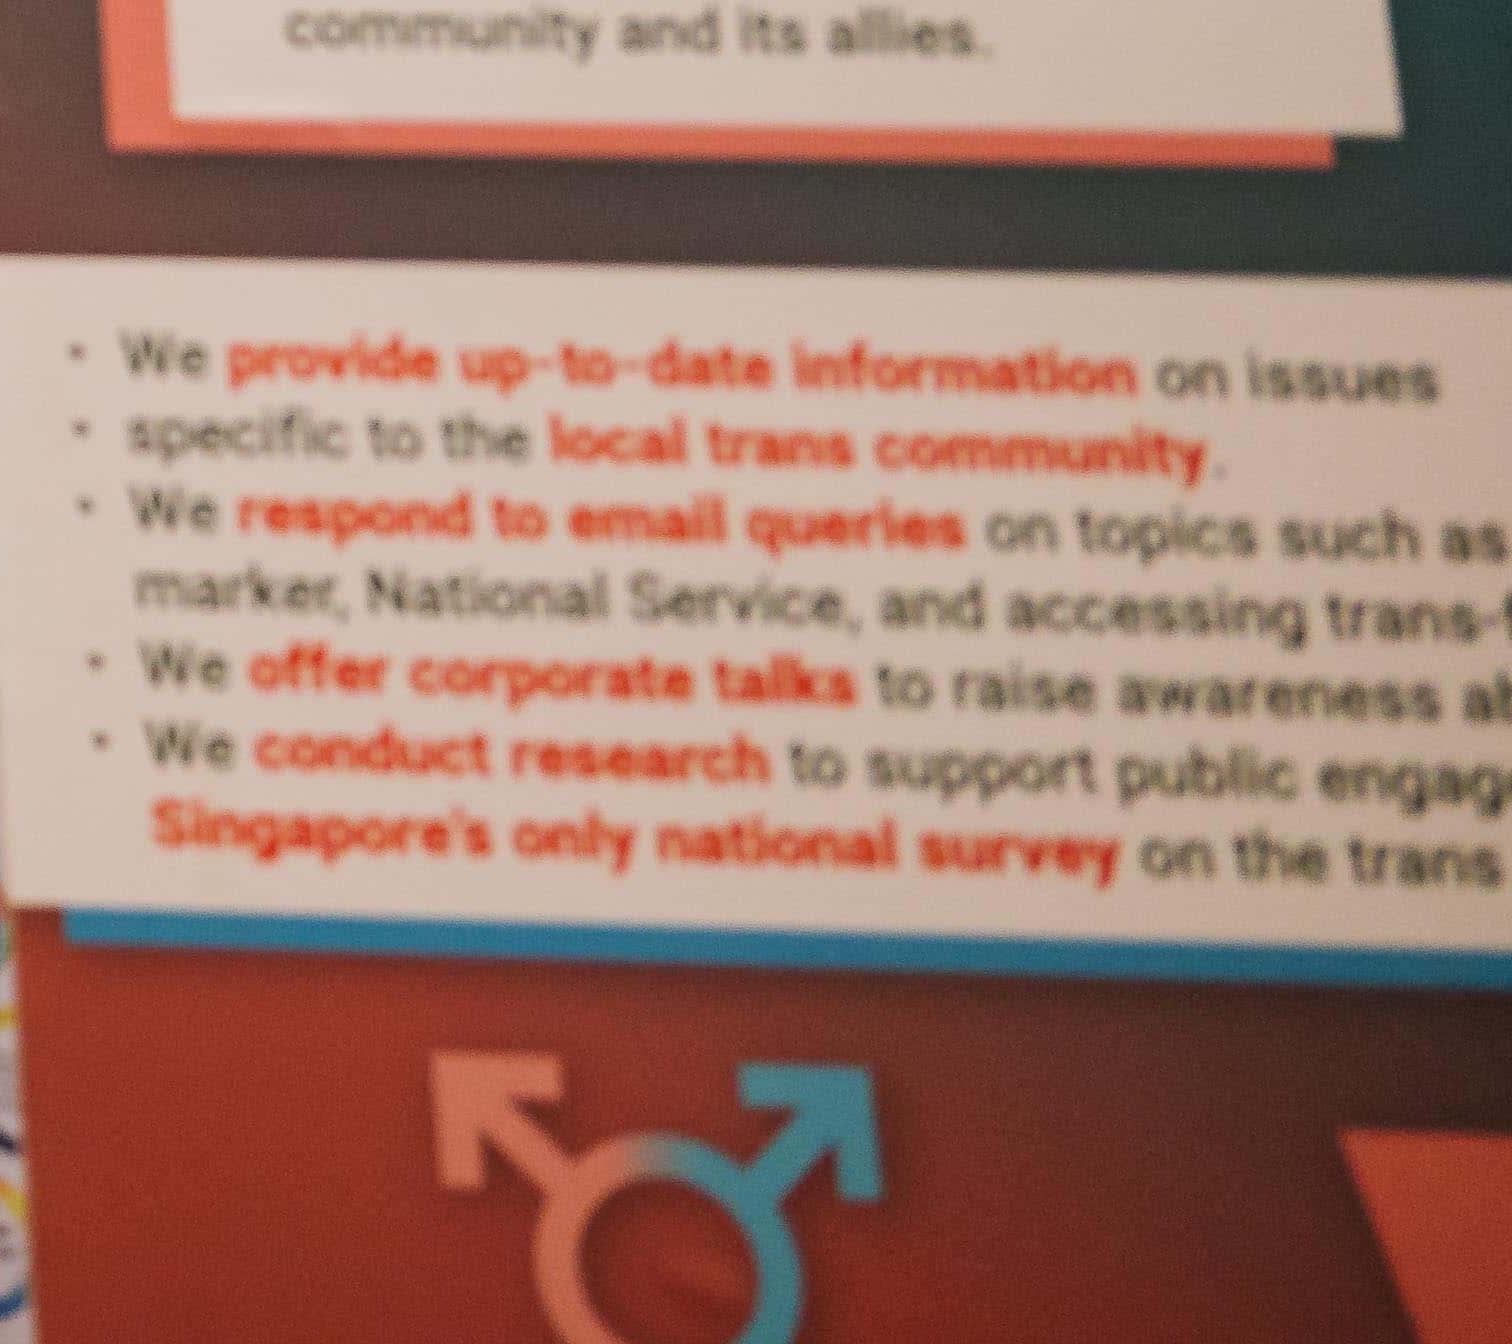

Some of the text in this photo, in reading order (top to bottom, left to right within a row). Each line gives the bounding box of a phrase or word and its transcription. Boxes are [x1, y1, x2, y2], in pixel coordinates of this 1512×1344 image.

[282, 6, 995, 64] community and its allies.
[118, 330, 1442, 404] We provide up-to-date information on issues
[126, 409, 351, 462] specific
[367, 415, 425, 462] to
[439, 415, 533, 465] the
[547, 412, 690, 466] local
[705, 421, 855, 471] trans
[127, 485, 1510, 567] We respond to email queries on topics such as
[132, 565, 349, 622] marker,
[365, 566, 610, 621] National
[626, 570, 862, 634] Service,
[879, 579, 987, 633] and
[1006, 583, 1309, 652] accessing
[138, 638, 231, 688] We
[247, 642, 390, 694] offer
[408, 654, 695, 712] corporate
[712, 655, 858, 709] talks
[875, 663, 935, 712] to
[951, 662, 1099, 714] raise
[1117, 672, 1443, 723] awareness
[142, 717, 1512, 819] We conduct research to support public engag
[150, 797, 1505, 889] Singapore's only national survey on the trans
